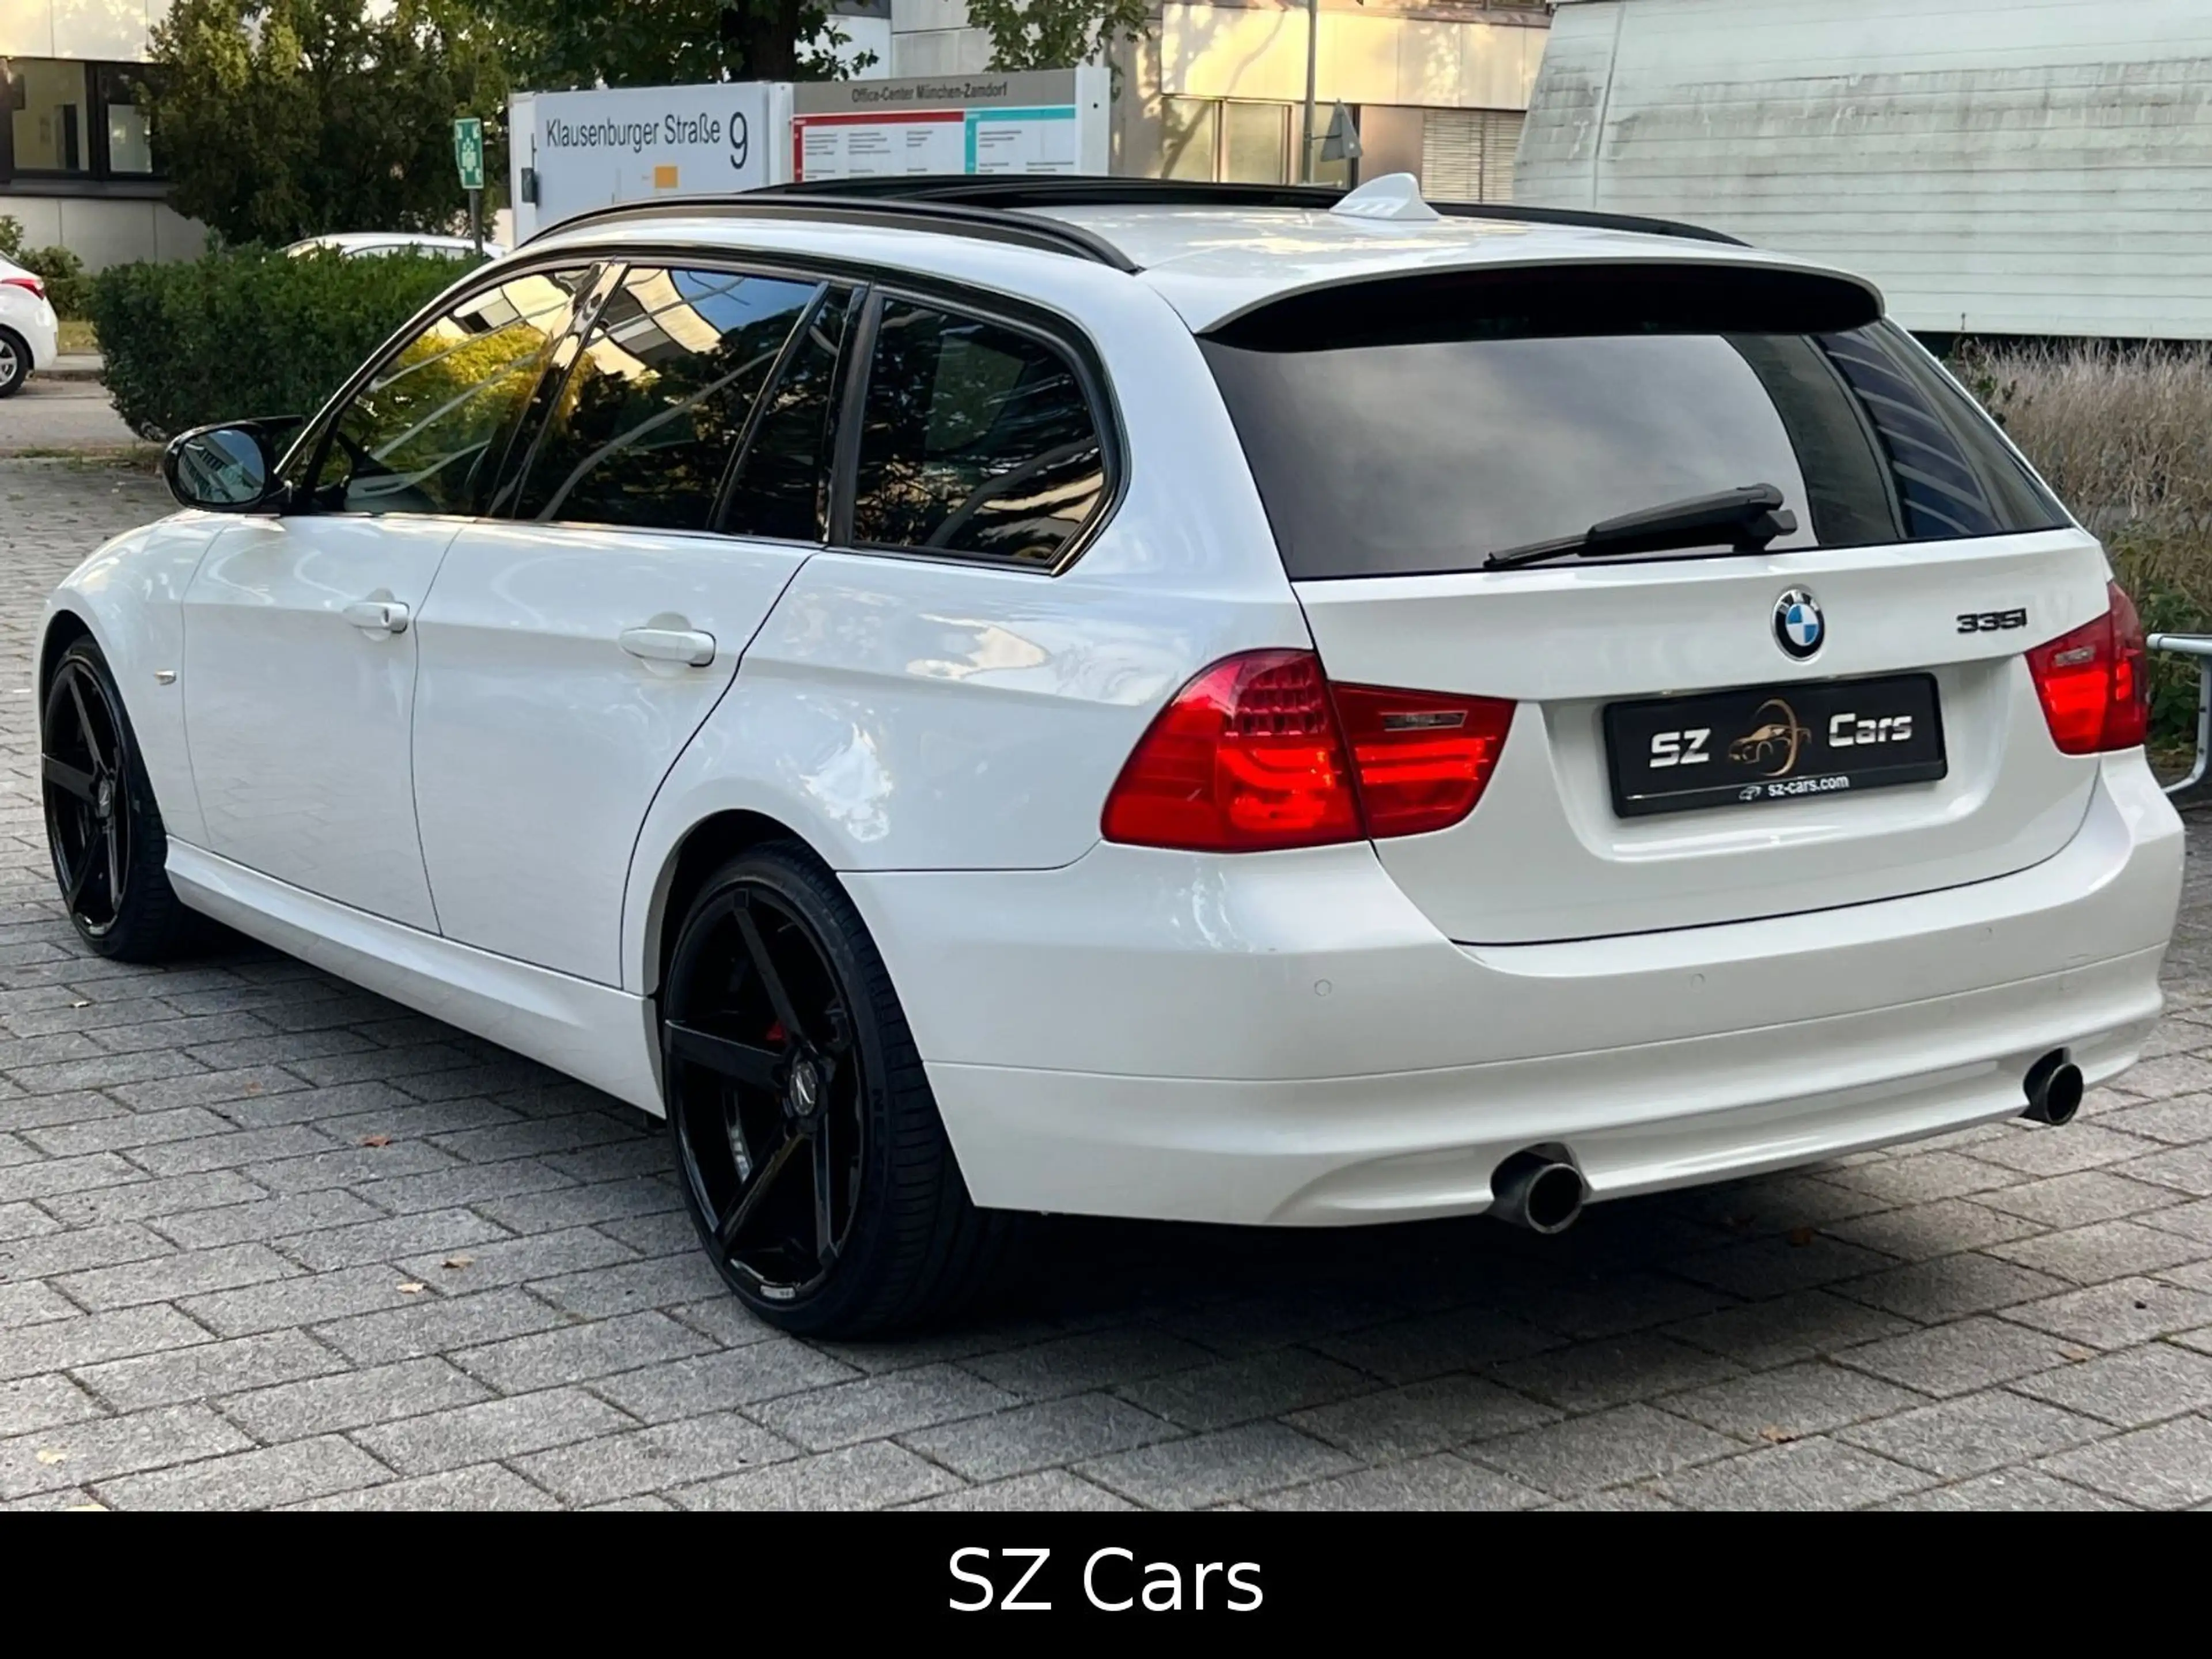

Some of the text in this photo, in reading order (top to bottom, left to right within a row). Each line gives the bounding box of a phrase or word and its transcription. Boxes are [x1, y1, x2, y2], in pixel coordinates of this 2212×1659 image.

[852, 86, 914, 102] Office-Center
[547, 111, 748, 169] Klausenburger Straße 9
[1957, 608, 2027, 633] 335i
[1649, 713, 1912, 768] SZ Cars
[1768, 775, 1849, 796] sz-cars.com
